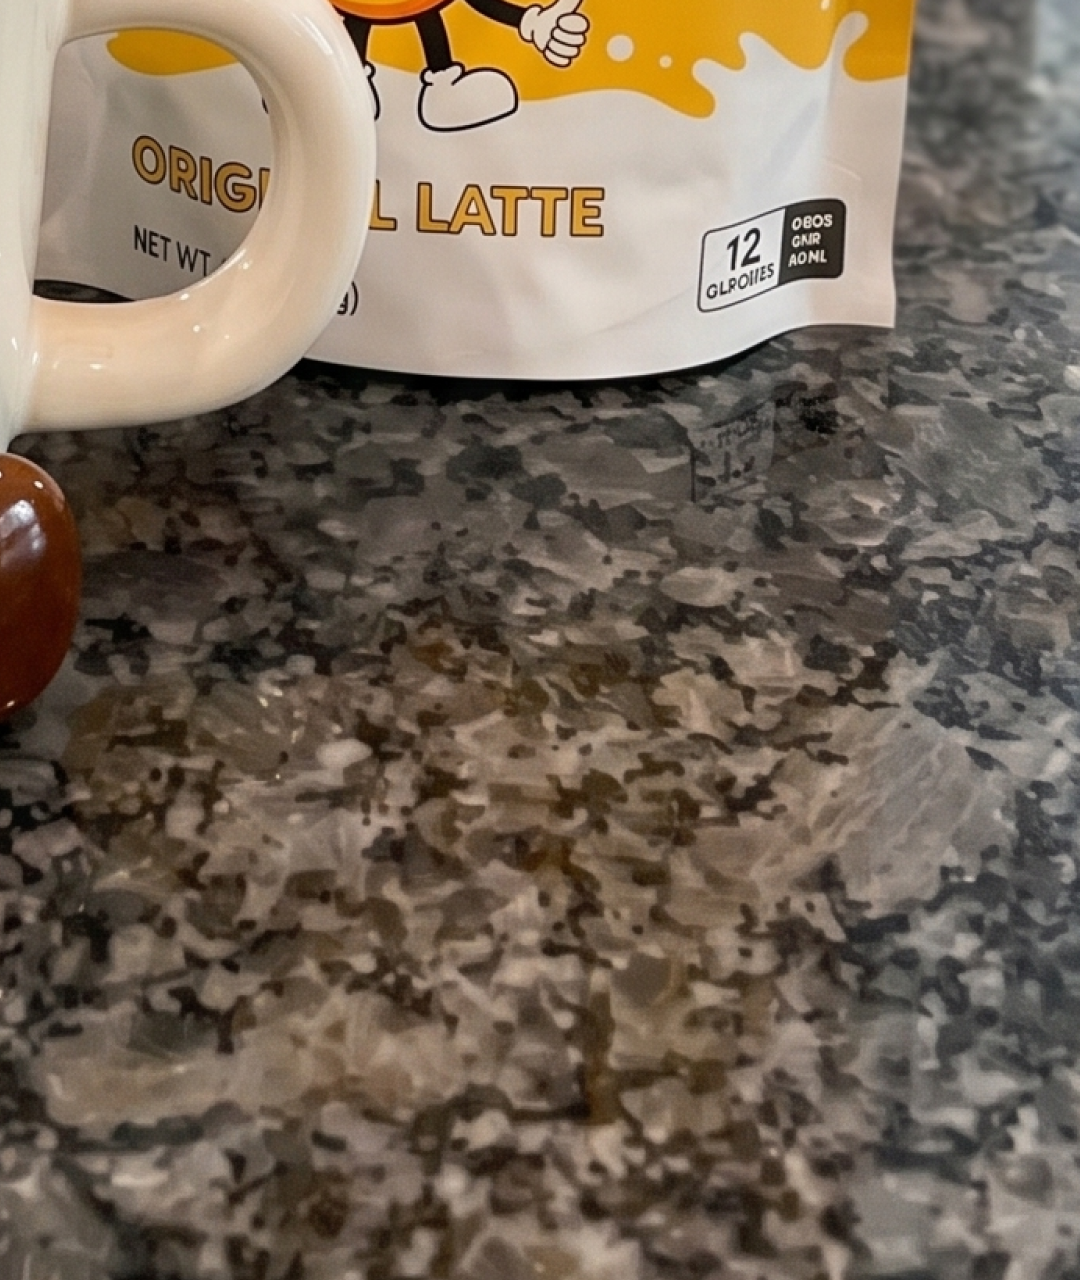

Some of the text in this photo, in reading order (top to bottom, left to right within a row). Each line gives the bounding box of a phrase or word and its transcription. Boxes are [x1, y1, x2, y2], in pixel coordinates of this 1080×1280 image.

[416, 181, 605, 237] LATTE
[133, 224, 212, 277] NET WT
[726, 227, 761, 272] 12
